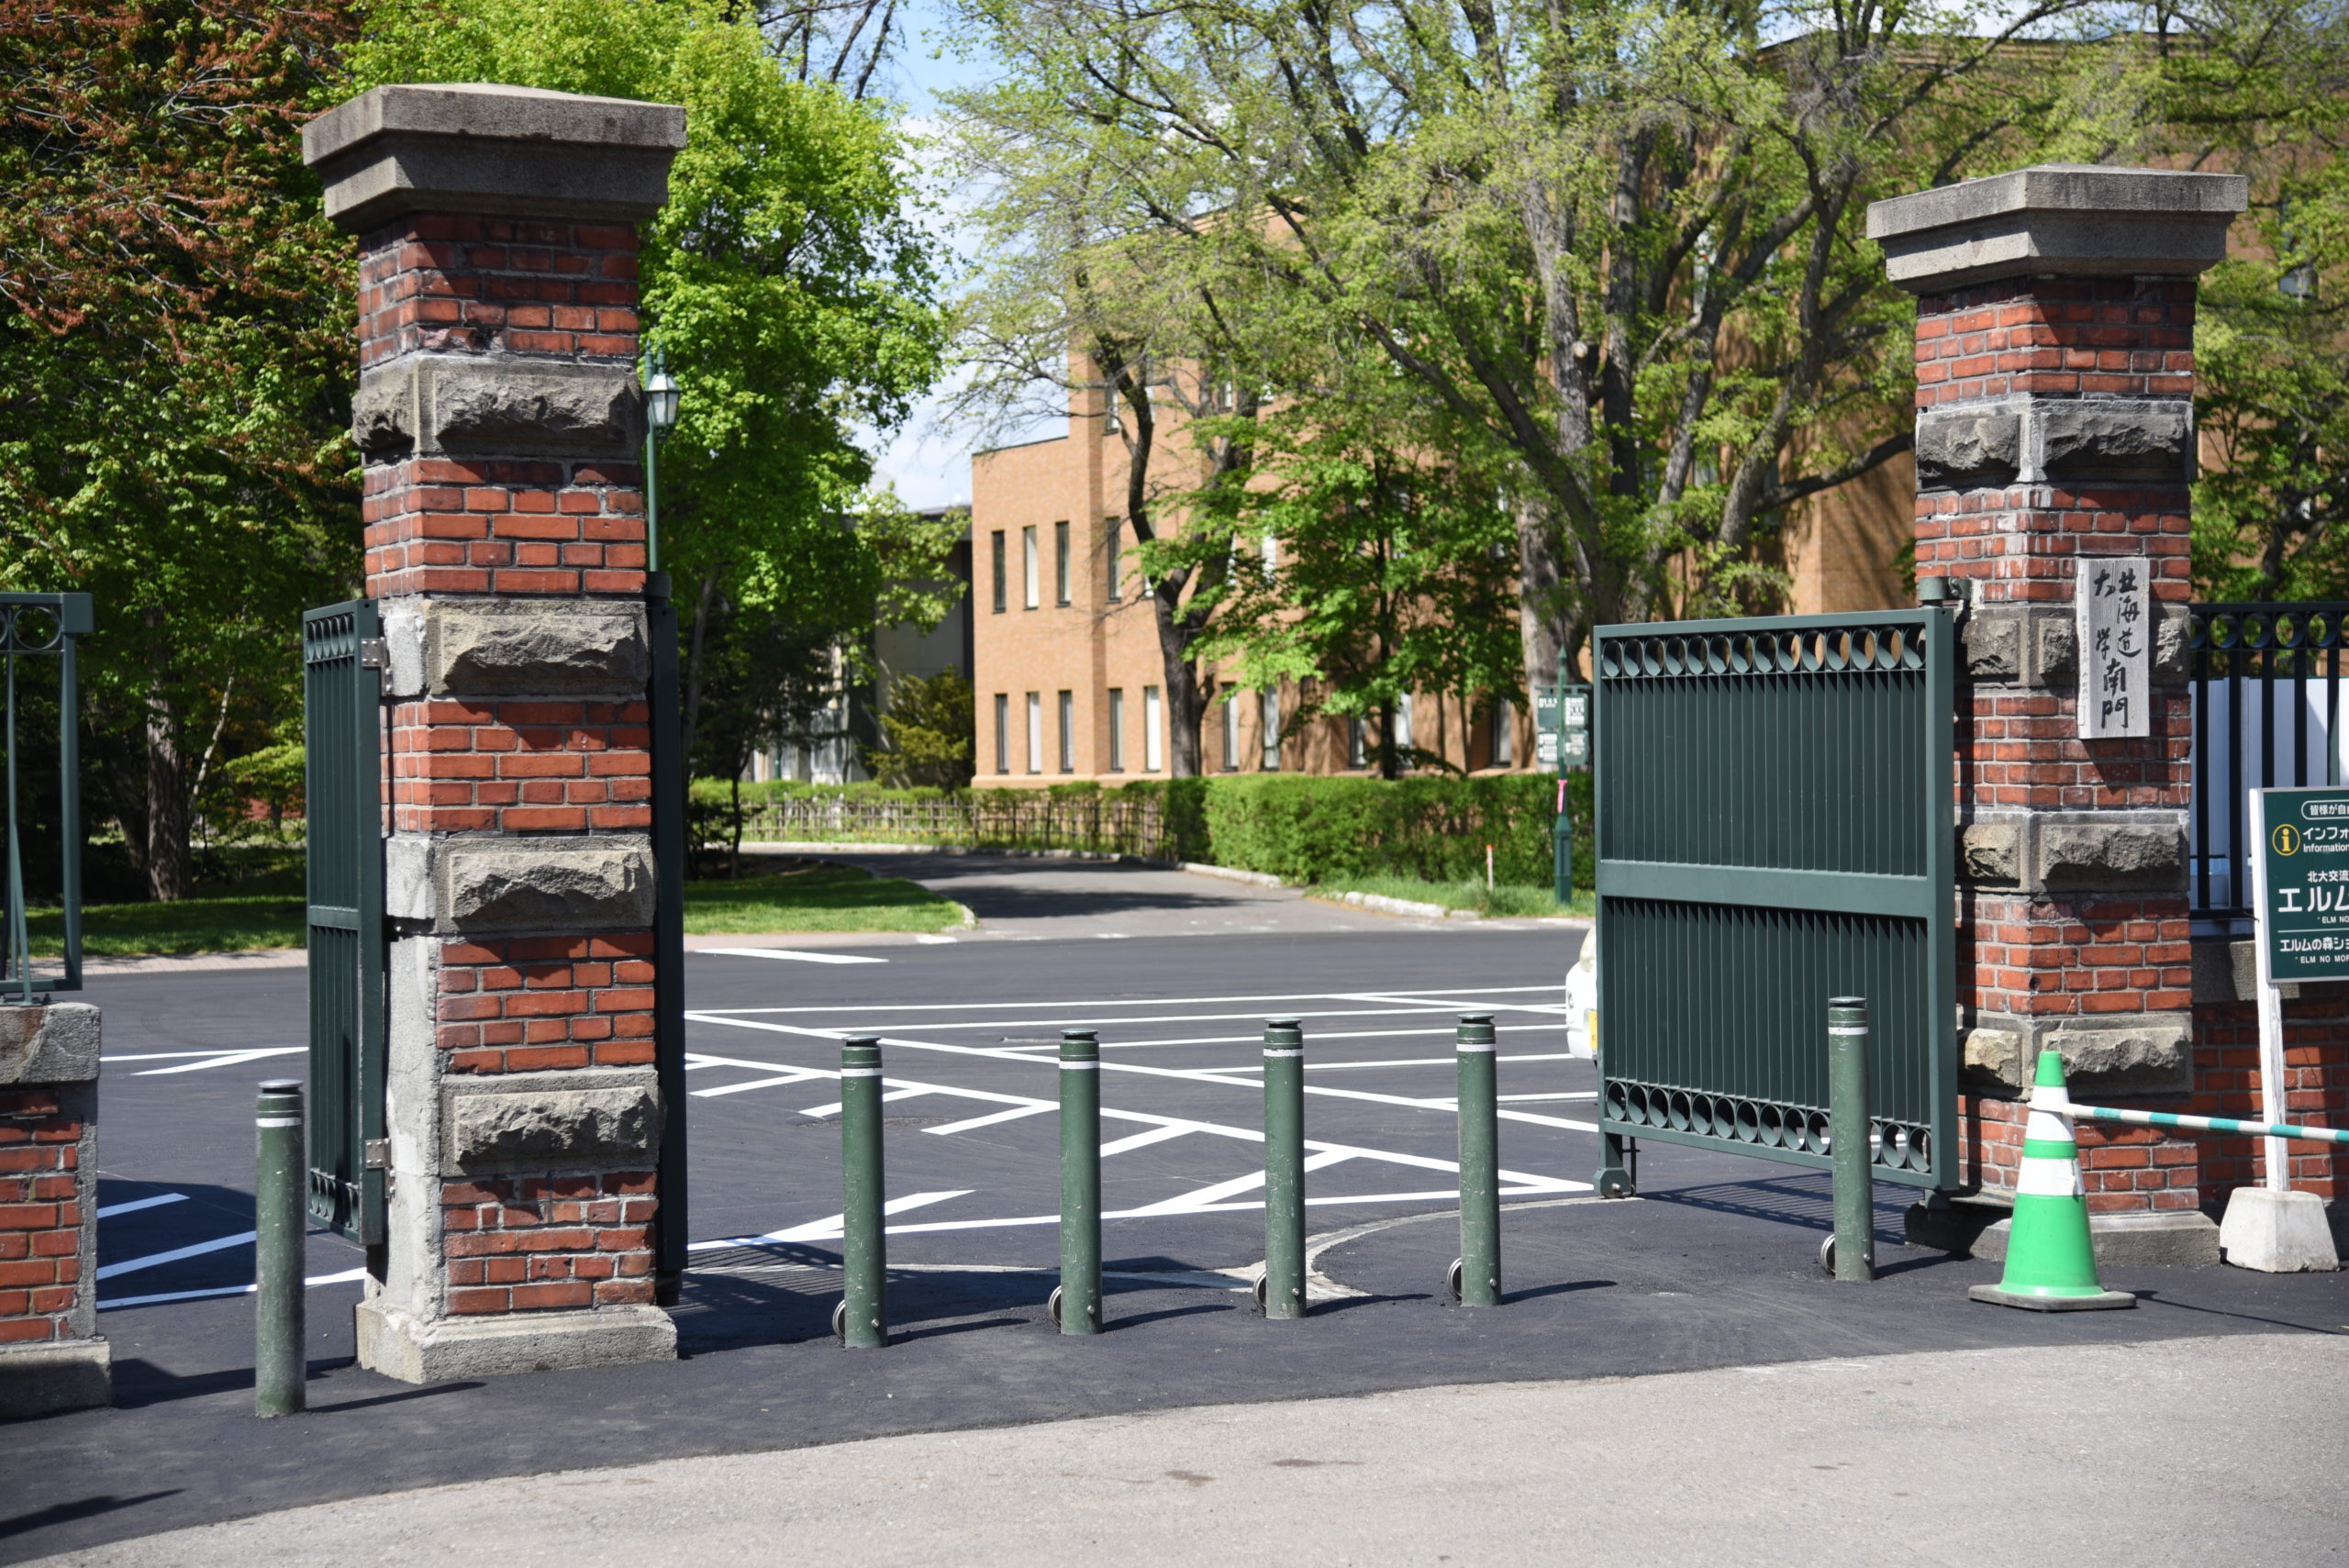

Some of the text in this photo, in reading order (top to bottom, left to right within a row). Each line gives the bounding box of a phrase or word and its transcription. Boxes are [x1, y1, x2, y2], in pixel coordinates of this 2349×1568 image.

[2310, 804, 2349, 816] 皆様が自
[2300, 956, 2316, 964] ELM
[2320, 955, 2331, 963] NO
